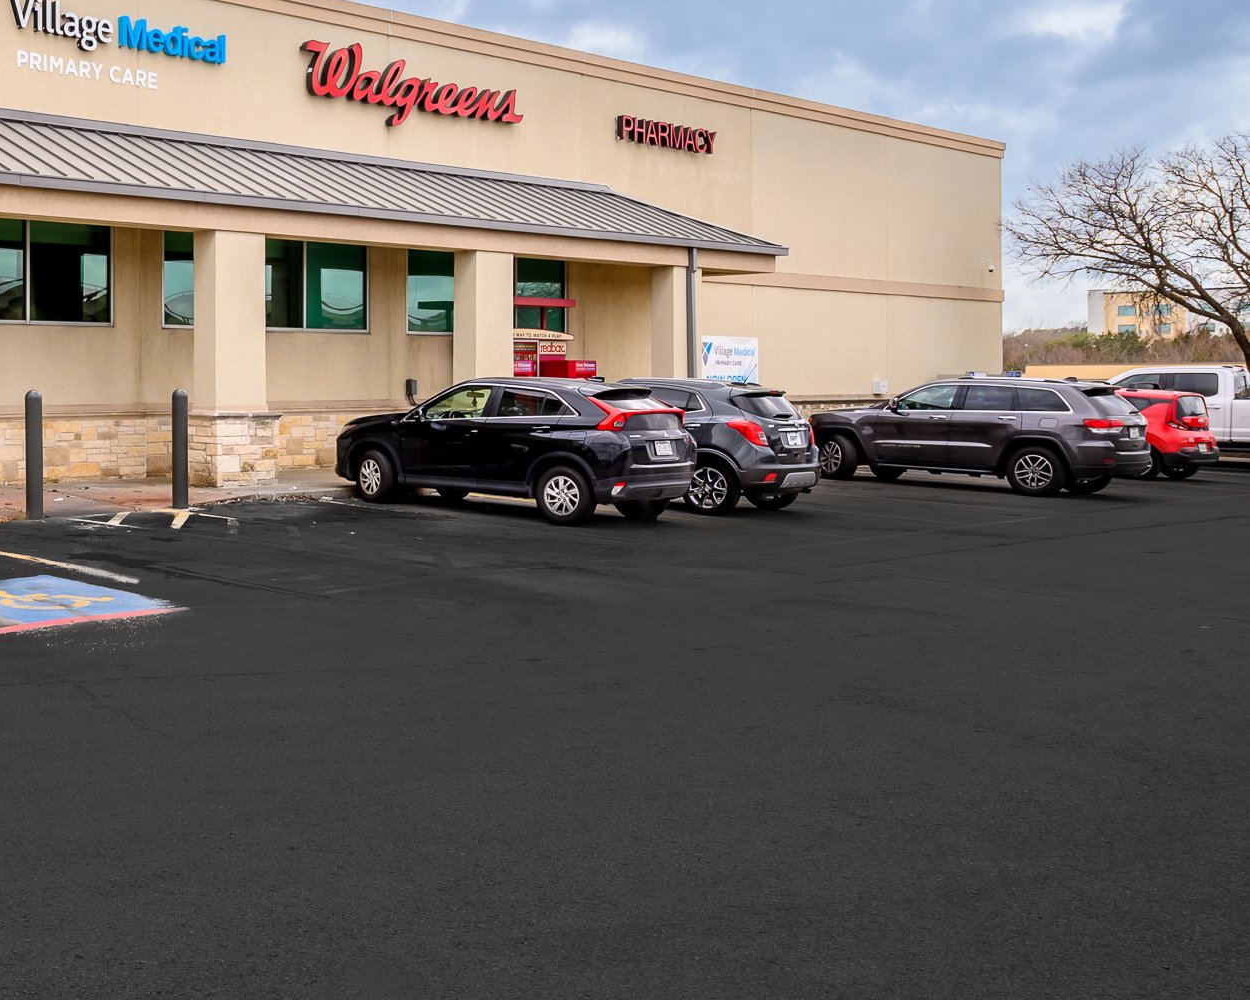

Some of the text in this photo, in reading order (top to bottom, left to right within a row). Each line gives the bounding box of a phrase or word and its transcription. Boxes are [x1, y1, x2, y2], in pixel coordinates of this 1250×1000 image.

[118, 15, 227, 64] Medical
[16, 49, 159, 90] PRIMARY CARE
[299, 39, 524, 128] Walgreens
[615, 115, 718, 156] PHARMACY
[714, 345, 756, 358] Village Medical
